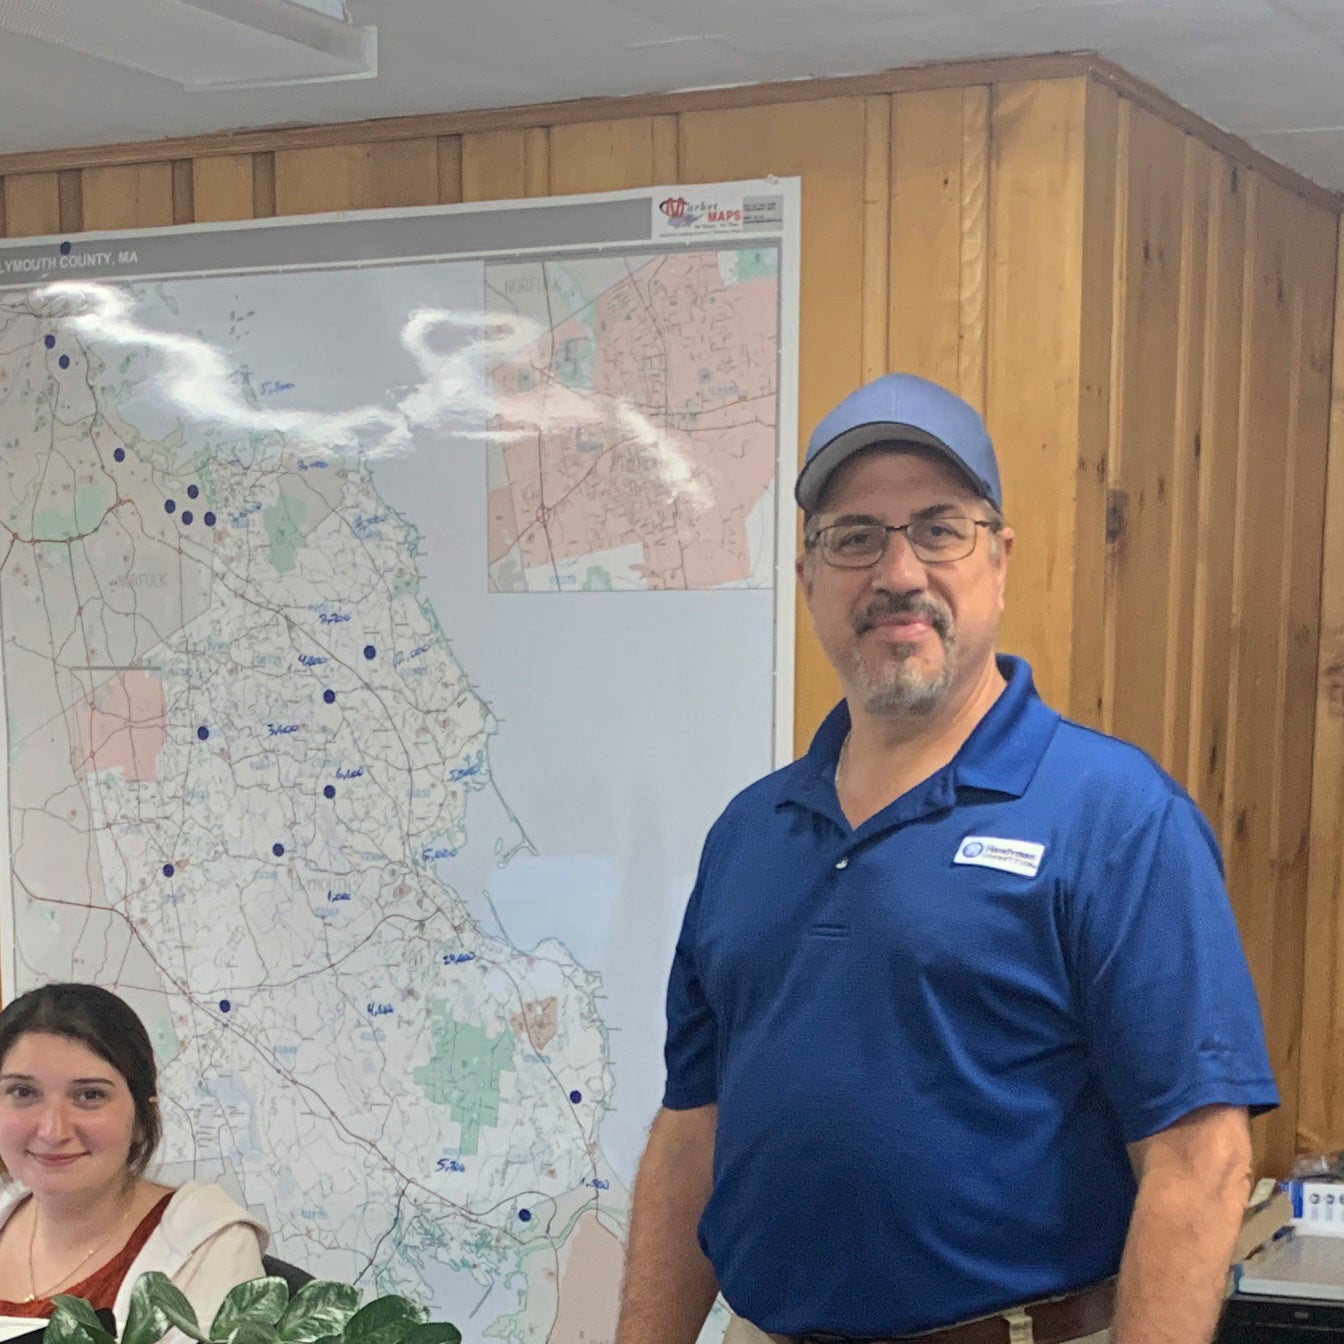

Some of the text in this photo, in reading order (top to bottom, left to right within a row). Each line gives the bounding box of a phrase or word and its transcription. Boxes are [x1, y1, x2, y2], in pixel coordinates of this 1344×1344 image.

[707, 210, 741, 222] MAPS
[59, 252, 115, 268] COUNTY,
[118, 251, 138, 263] MA
